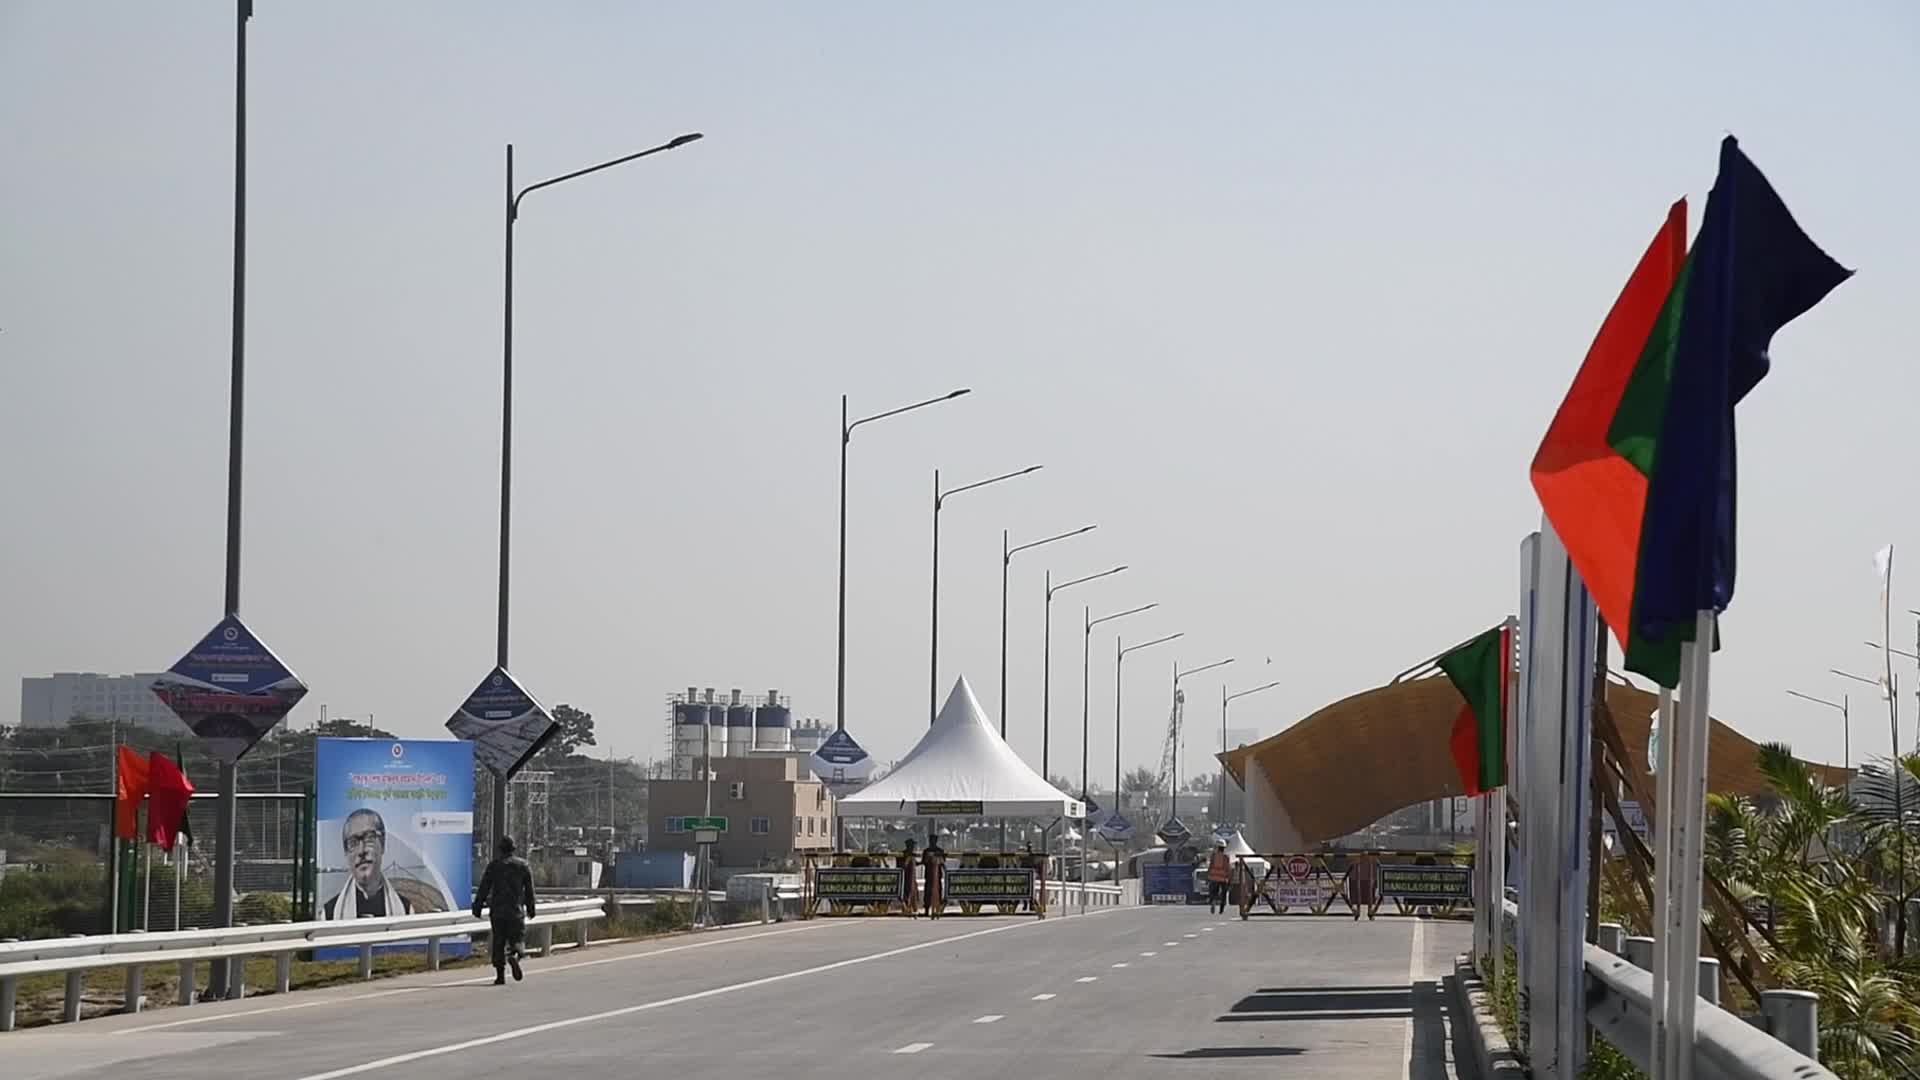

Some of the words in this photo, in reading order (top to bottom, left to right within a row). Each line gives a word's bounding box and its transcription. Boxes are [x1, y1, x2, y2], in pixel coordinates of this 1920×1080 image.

[1290, 862, 1307, 873] STOP
[819, 883, 873, 893] BANGLADESH
[876, 883, 897, 893] NAVY
[949, 885, 1004, 894] BANGLADESH
[1007, 885, 1028, 894] NAVY
[1383, 882, 1440, 891] BANGLADESH
[1443, 882, 1466, 891] NAVY
